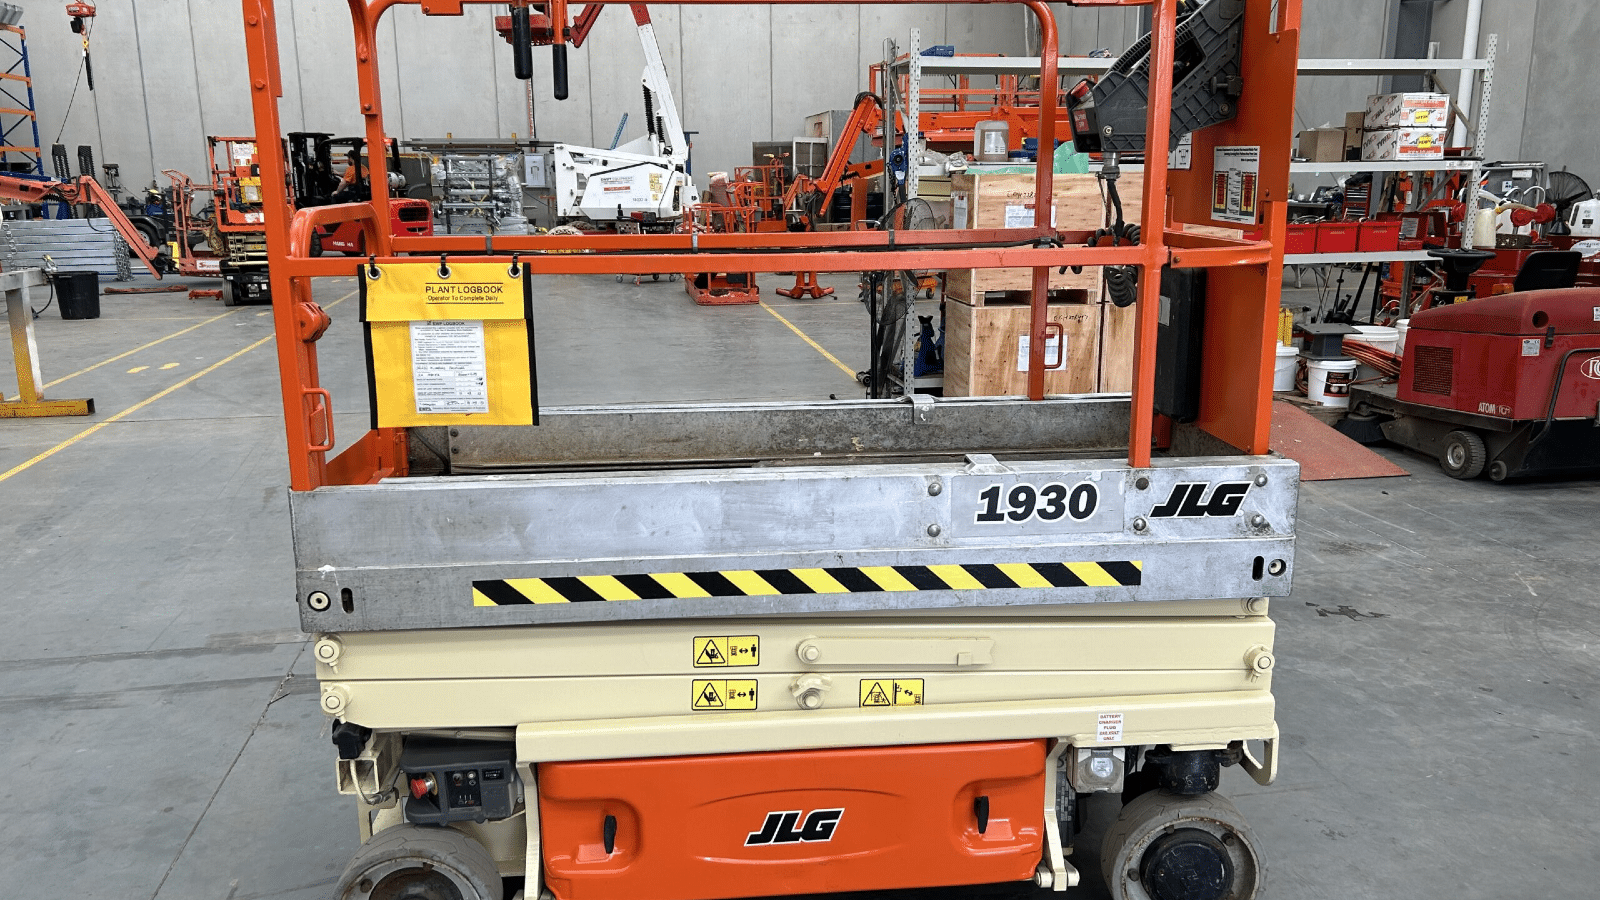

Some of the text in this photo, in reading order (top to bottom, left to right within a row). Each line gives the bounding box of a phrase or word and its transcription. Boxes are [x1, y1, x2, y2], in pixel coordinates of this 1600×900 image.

[425, 285, 504, 294] PLANT LOGBOOK
[485, 294, 499, 302] Daily
[1478, 402, 1496, 415] ATOM
[975, 483, 1098, 524] 1930
[1150, 481, 1252, 518] JLG
[743, 807, 845, 847] JLG
